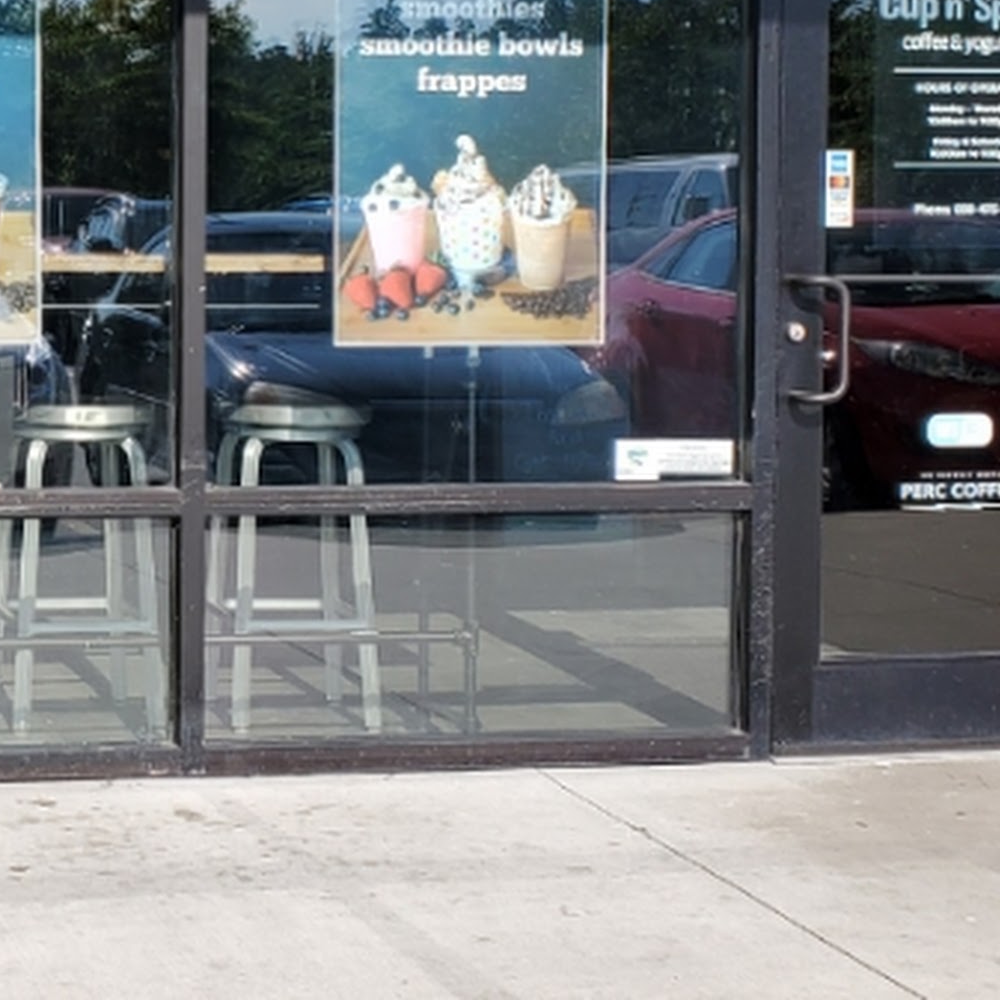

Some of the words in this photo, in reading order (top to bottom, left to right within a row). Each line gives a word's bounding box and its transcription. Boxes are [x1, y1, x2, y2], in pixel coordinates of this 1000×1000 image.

[359, 31, 491, 57] smoothie
[498, 31, 584, 58] bowls
[902, 31, 949, 52] coffee
[950, 33, 963, 52] &
[416, 66, 528, 98] frappes
[900, 482, 947, 499] PERC
[950, 481, 1000, 499] COFF
